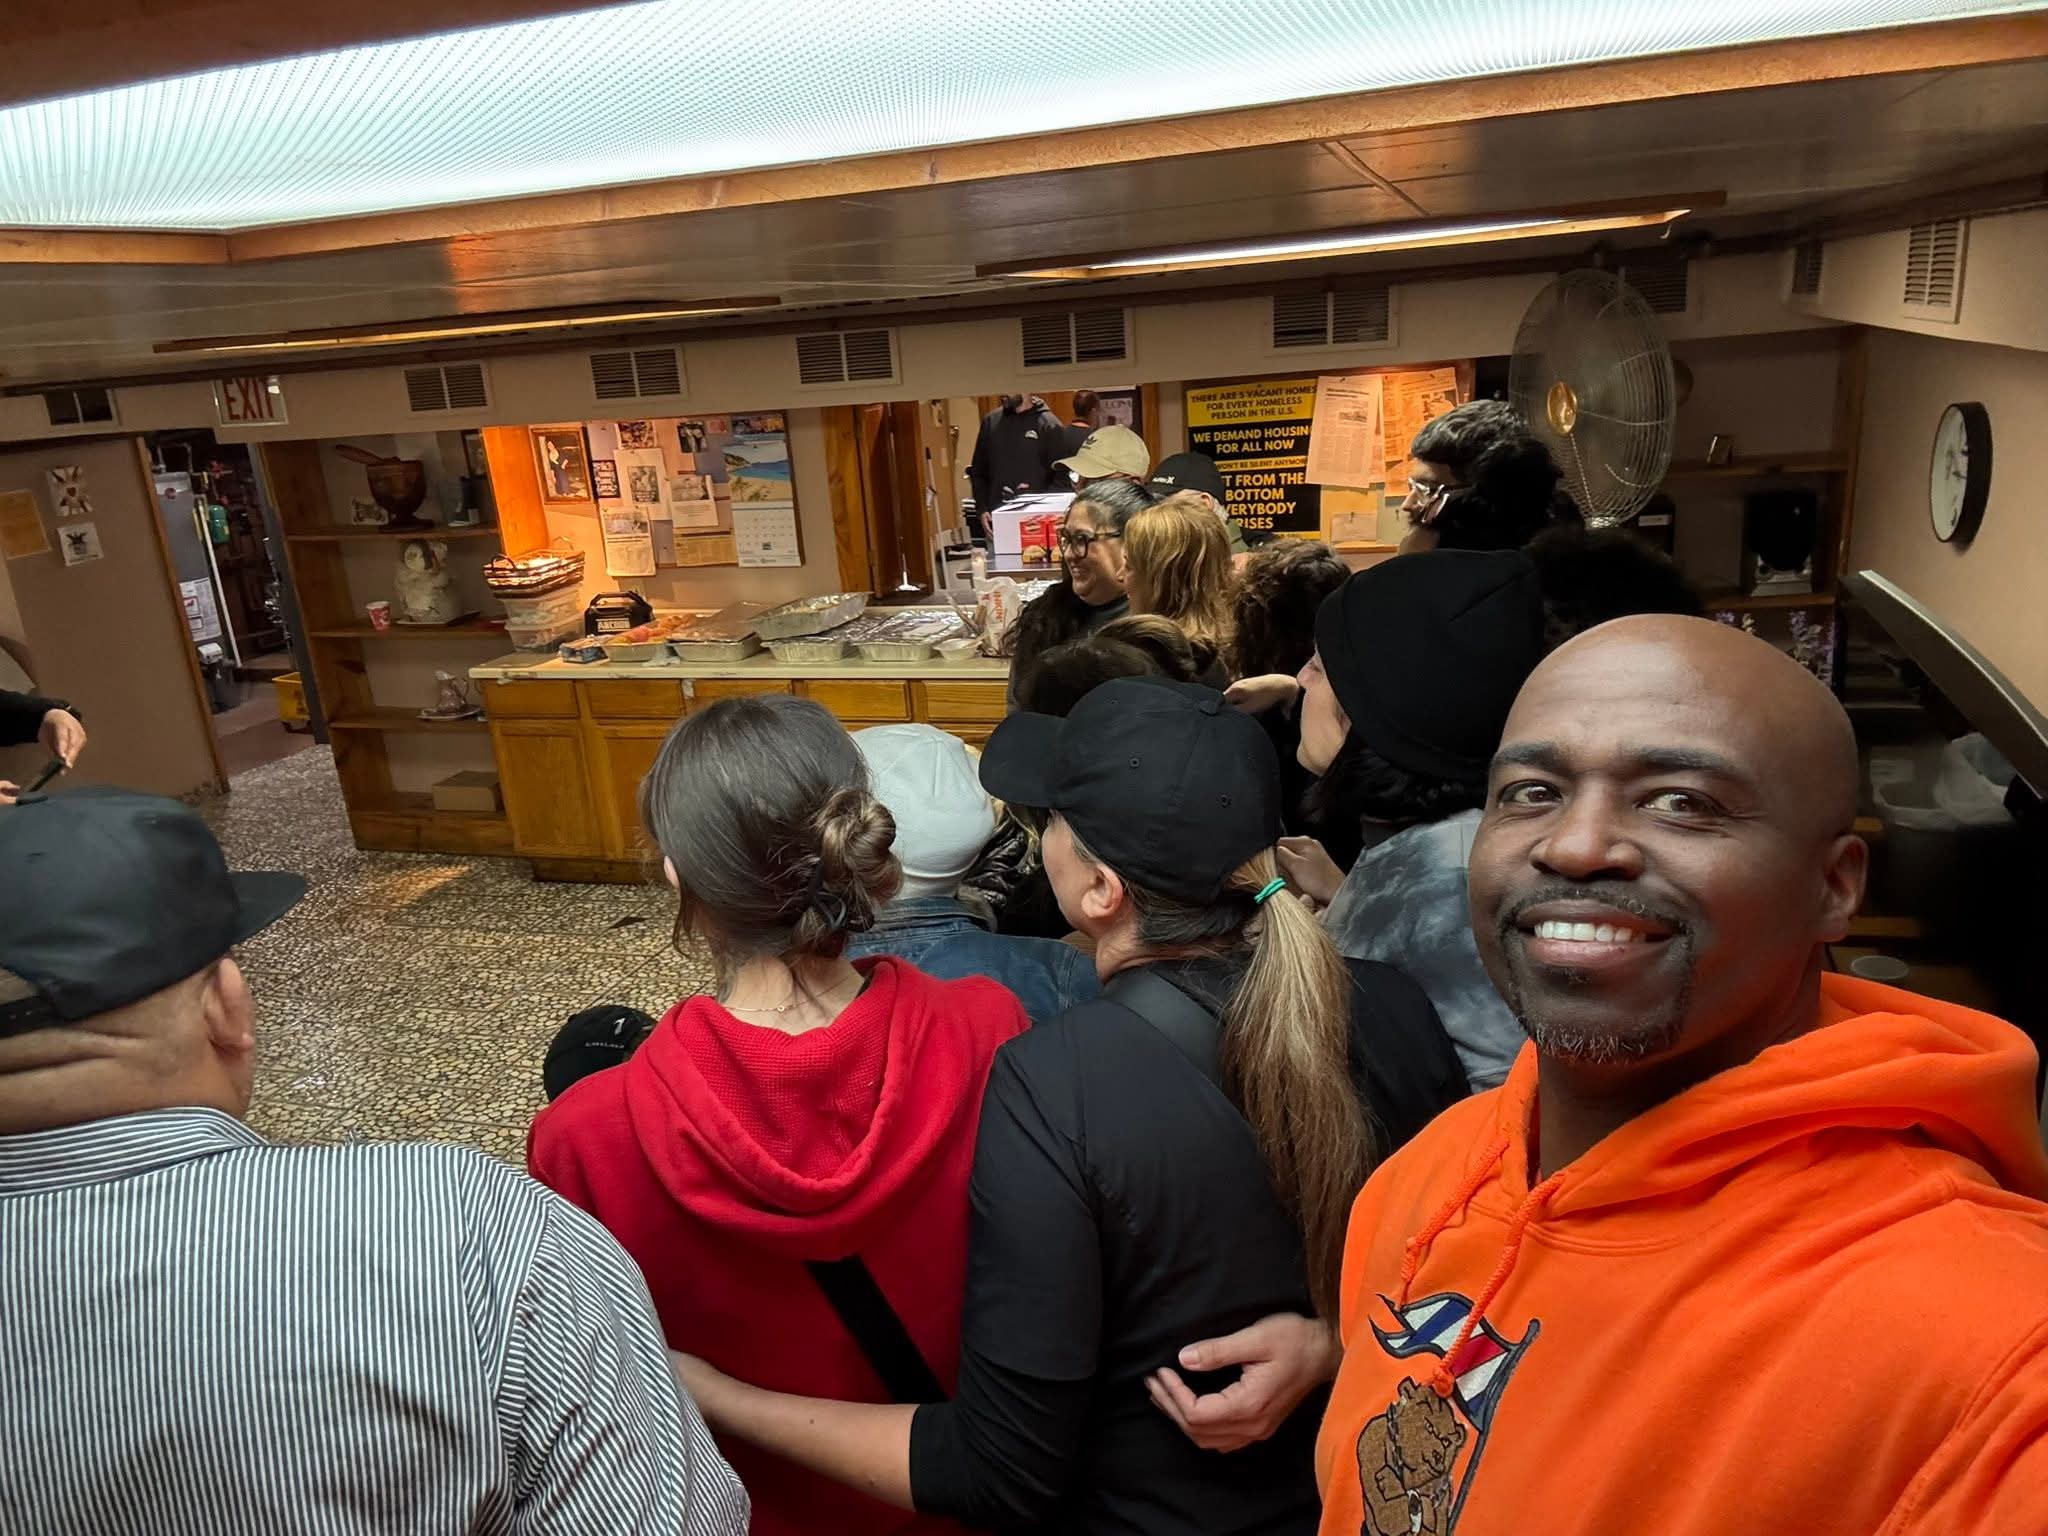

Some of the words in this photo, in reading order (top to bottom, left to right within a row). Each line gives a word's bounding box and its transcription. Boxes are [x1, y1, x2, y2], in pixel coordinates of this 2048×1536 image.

[222, 377, 275, 420] EXIT
[1191, 393, 1217, 403] THERE
[1221, 391, 1237, 400] ARE
[1247, 387, 1283, 398] VACANT
[1286, 384, 1317, 394] HOMES
[1206, 402, 1225, 411] FOR
[1226, 400, 1254, 410] EVERY
[1256, 397, 1303, 407] HOMELESS
[1211, 410, 1246, 420] PERSON
[1248, 409, 1258, 417] IN
[1260, 407, 1276, 416] THE
[1279, 407, 1296, 415] U.S.
[1193, 433, 1211, 443] WE
[1214, 429, 1262, 442] DEMAND
[1264, 425, 1312, 438] HOUSIN
[1216, 443, 1239, 454] FOR
[1241, 442, 1262, 452] ALL
[1264, 439, 1295, 450] NOW
[1235, 474, 1276, 487] FROM
[1279, 472, 1305, 485] THE
[1225, 488, 1285, 501] BOTTOM
[1225, 502, 1296, 516] VERYBODY
